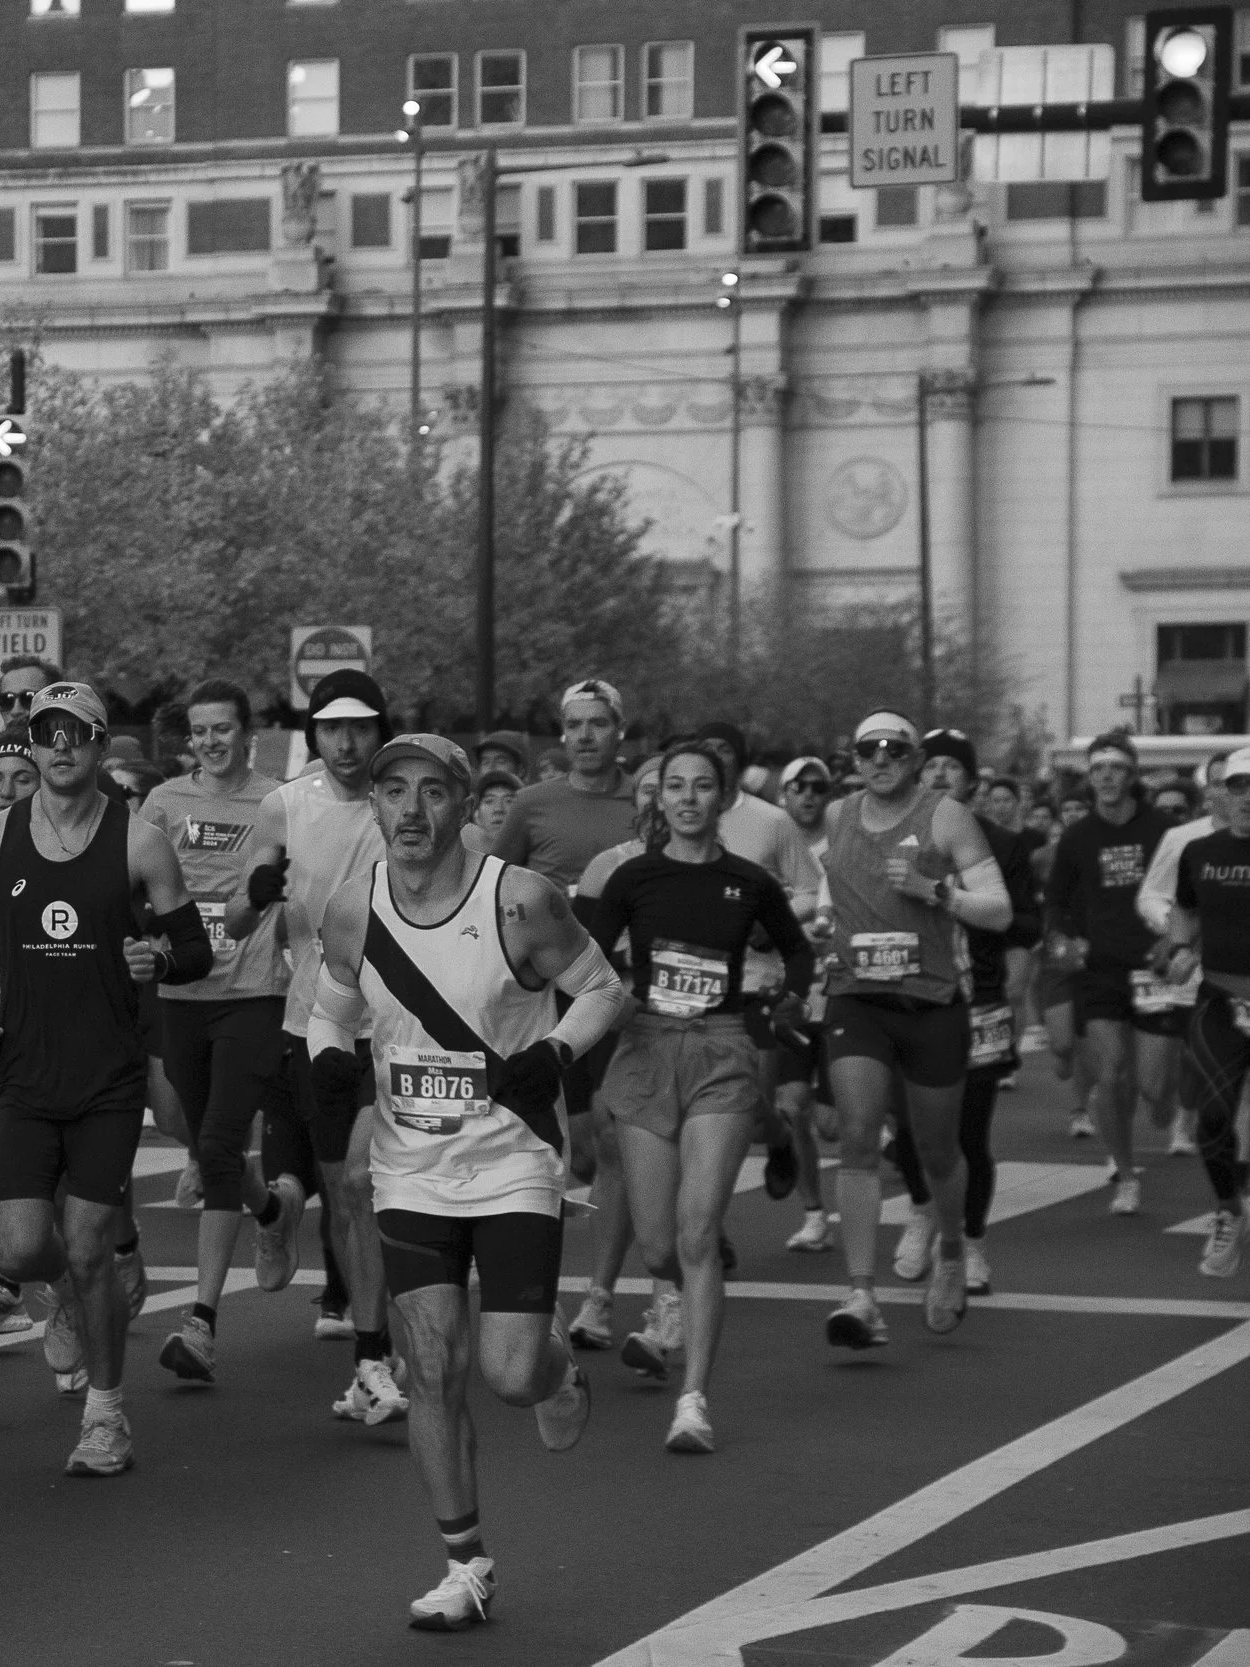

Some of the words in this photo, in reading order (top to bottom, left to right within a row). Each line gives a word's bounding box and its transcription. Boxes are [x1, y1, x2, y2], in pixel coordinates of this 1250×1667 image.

[876, 70, 931, 96] LEFT
[872, 107, 934, 133] TURN
[863, 144, 948, 171] SIGNAL
[17, 614, 48, 628] TURN
[658, 970, 669, 987] B
[674, 974, 722, 995] 17174
[417, 1054, 452, 1064] MARATHON
[400, 1073, 414, 1096] B
[420, 1075, 474, 1099] 8076
